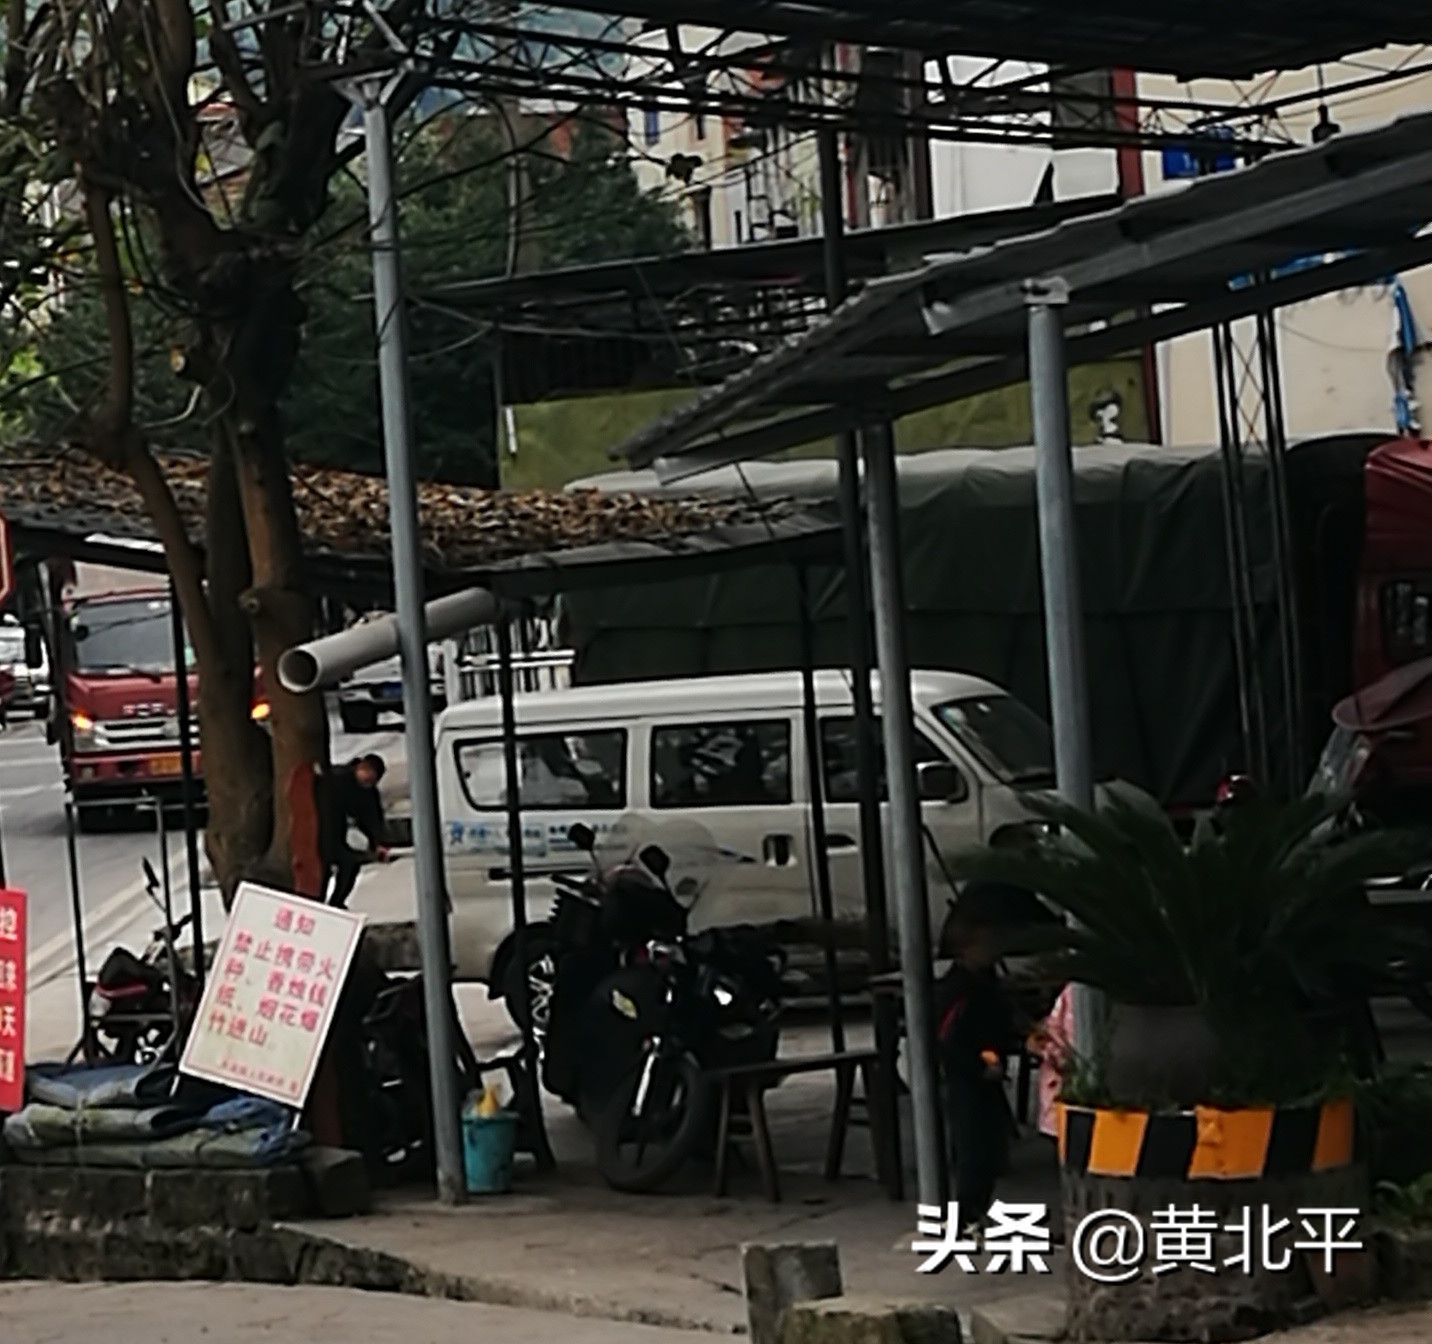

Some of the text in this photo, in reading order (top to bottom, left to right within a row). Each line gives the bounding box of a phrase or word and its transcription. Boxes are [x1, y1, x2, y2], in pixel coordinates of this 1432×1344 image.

[274, 907, 316, 936] 通知
[233, 930, 335, 980] 禁止携带火
